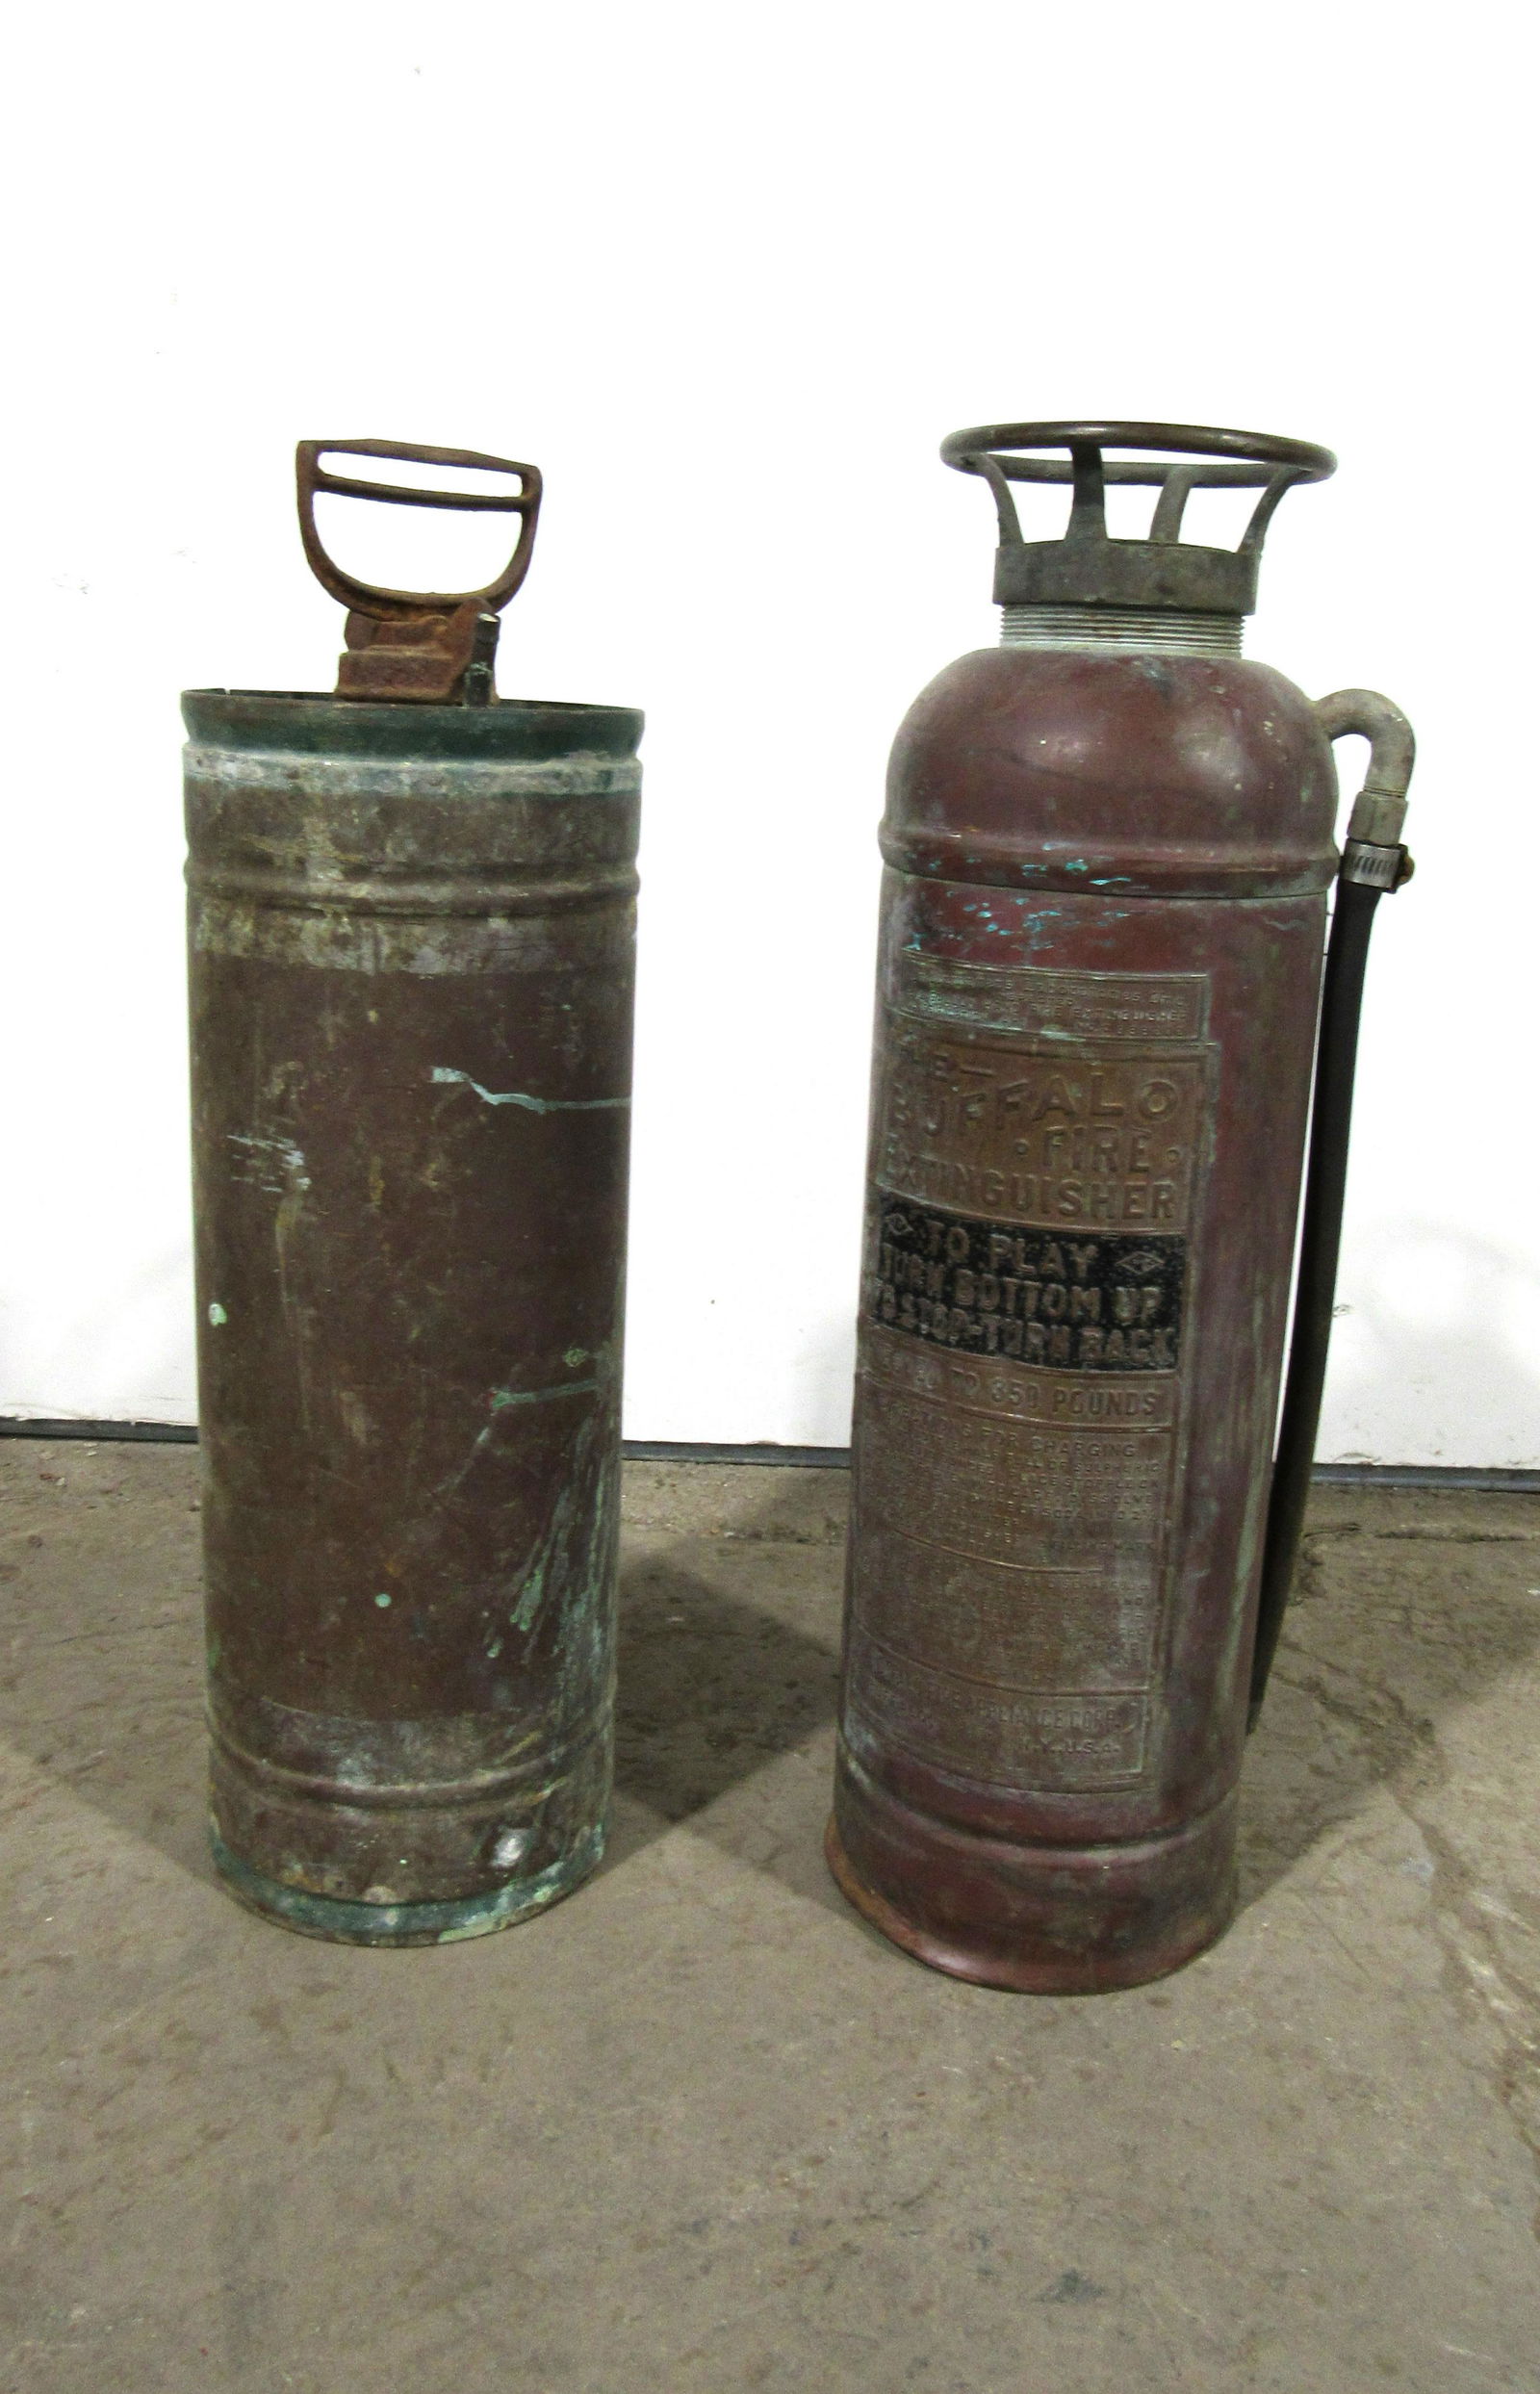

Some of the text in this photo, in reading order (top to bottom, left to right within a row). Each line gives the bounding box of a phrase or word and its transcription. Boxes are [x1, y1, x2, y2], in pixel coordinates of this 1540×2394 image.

[1043, 1123, 1154, 1174] FIRE
[988, 1233, 1099, 1279] PLAY
[954, 1268, 1102, 1323] BOTTOM
[1114, 1286, 1161, 1326] UP
[1051, 1383, 1159, 1417] POUNDS
[1030, 1433, 1139, 1458] CHARGING
